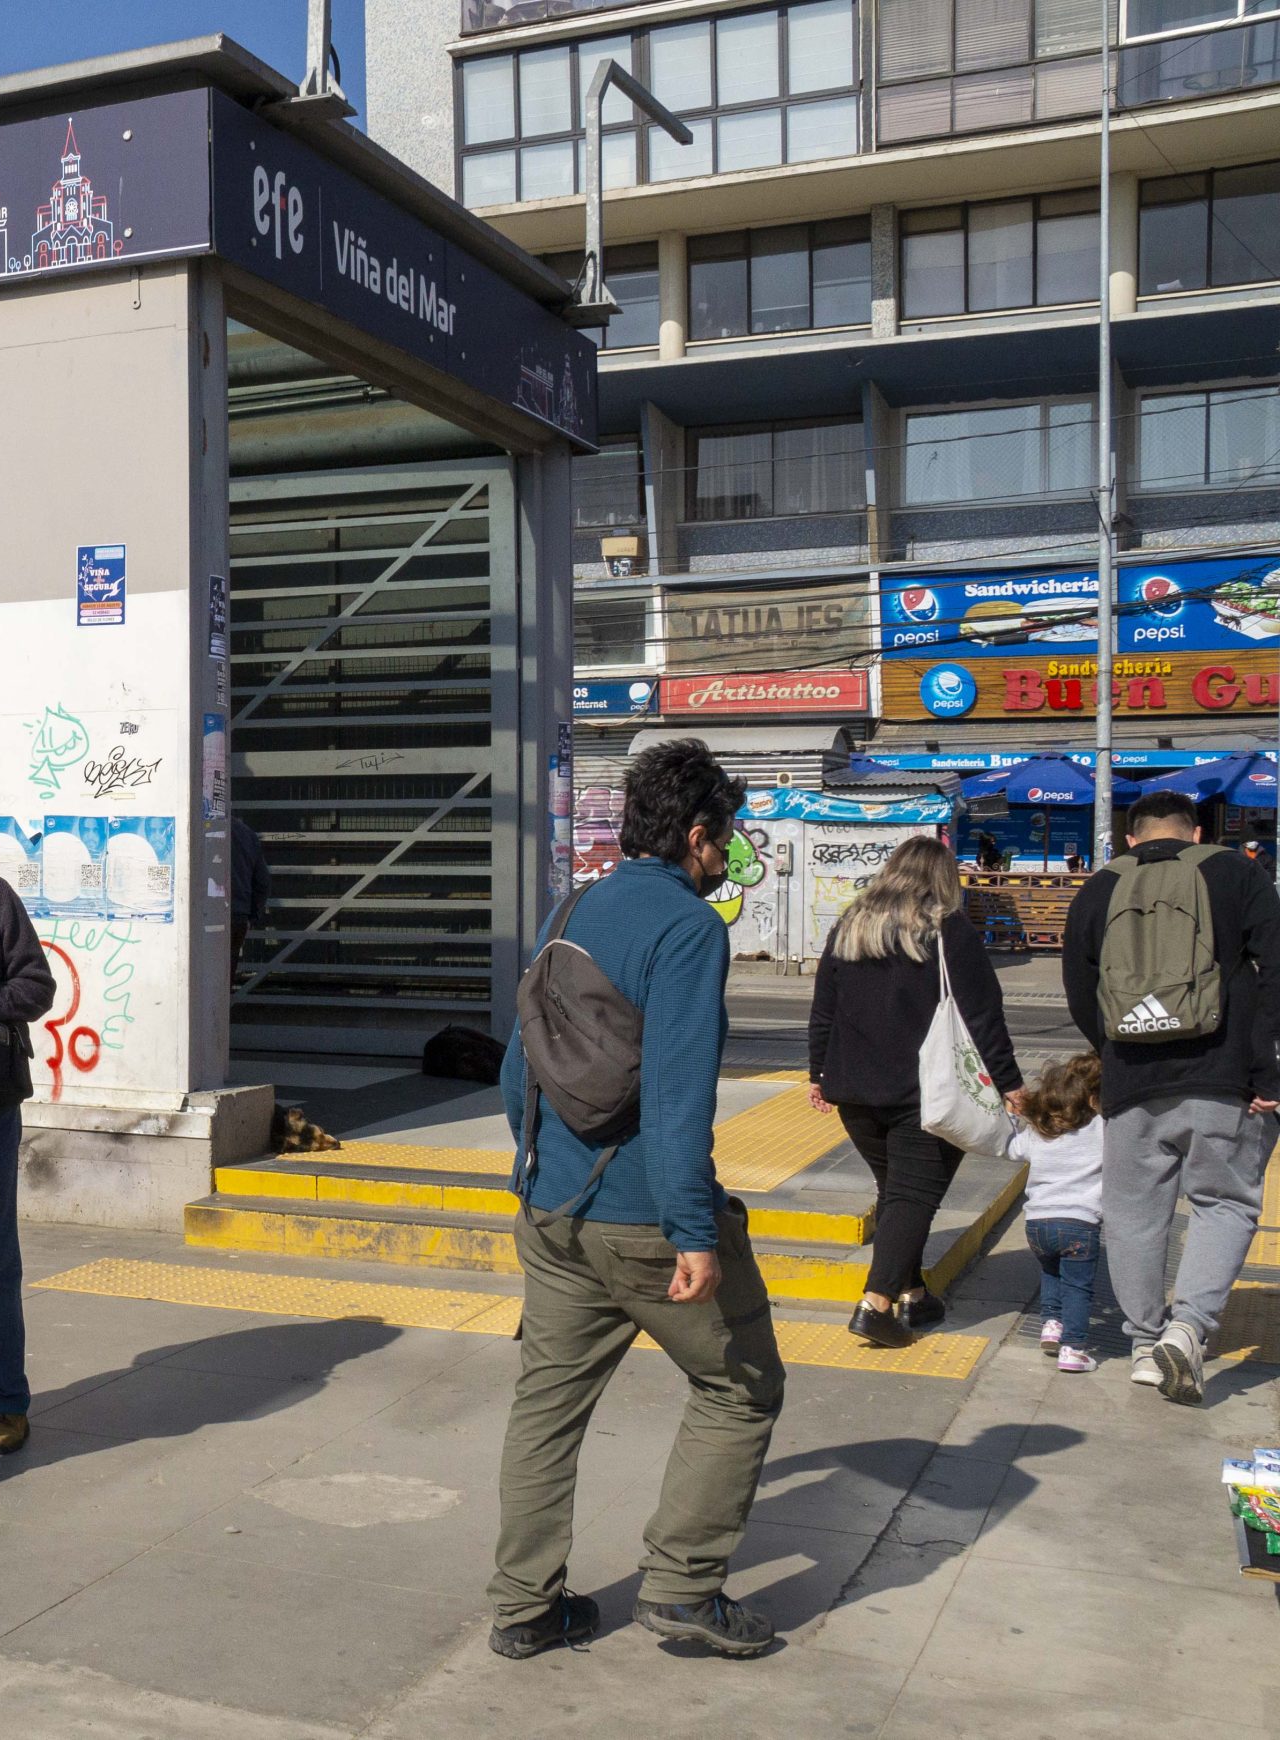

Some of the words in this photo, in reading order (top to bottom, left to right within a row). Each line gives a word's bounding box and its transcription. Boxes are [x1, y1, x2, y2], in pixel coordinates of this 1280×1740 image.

[253, 165, 304, 260] efe
[332, 220, 381, 294] Viña
[385, 257, 415, 314] del
[419, 274, 457, 336] Mar
[964, 576, 1099, 598] Sandwichería
[685, 603, 844, 643] TATUAJES
[893, 629, 940, 646] pepsi
[1134, 624, 1184, 643] pepsi
[688, 679, 841, 708] Artistattoo
[933, 698, 964, 710] pepsi
[931, 757, 986, 768] Sandwichería
[1122, 754, 1148, 763] pepsi
[1043, 791, 1075, 802] pepsi
[1118, 1016, 1181, 1034] adidas
